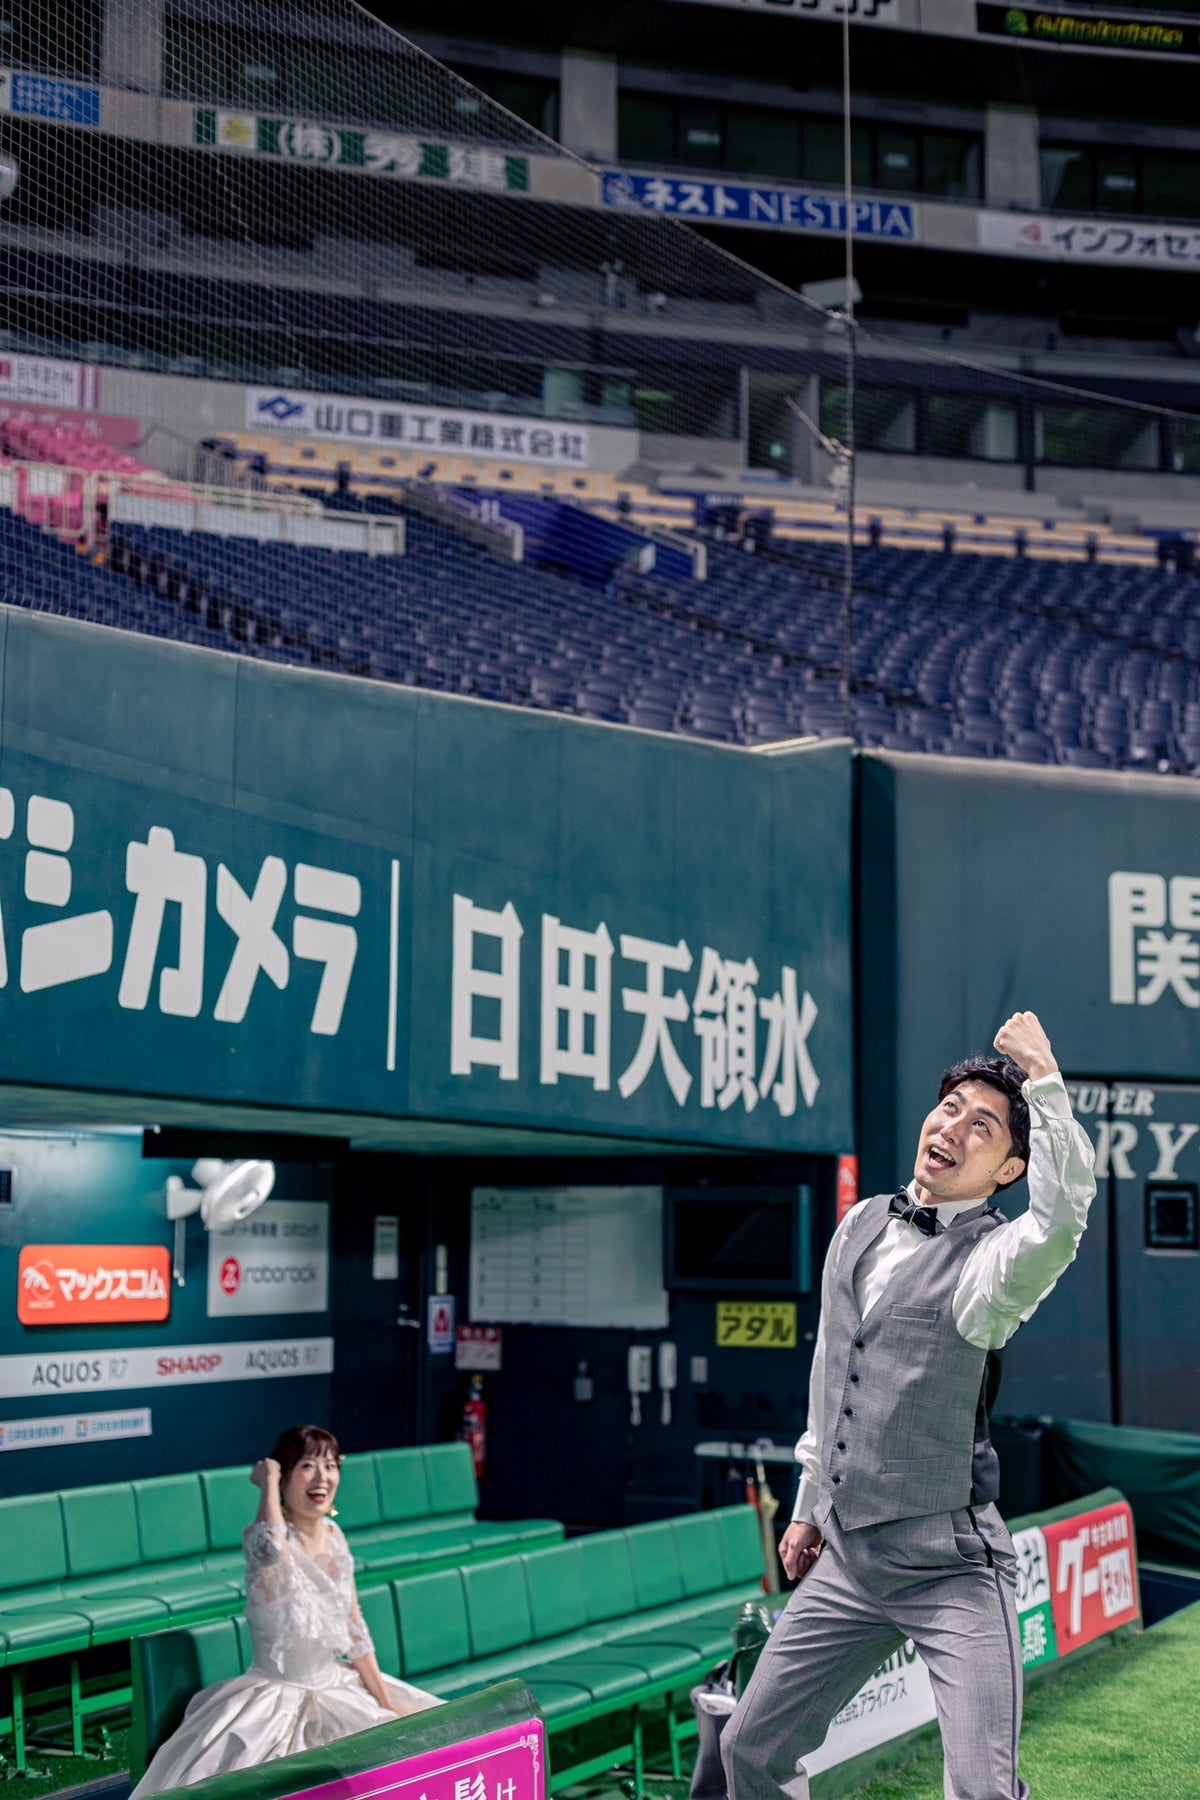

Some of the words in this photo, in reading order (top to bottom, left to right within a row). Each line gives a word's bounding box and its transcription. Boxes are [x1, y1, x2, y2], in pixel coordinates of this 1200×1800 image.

[643, 178, 739, 216] ネスト
[750, 190, 911, 236] NESTPIA
[1053, 226, 1200, 260] インフォセ
[315, 403, 583, 461] 山口重工業株式会社
[1108, 871, 1200, 1008] 関
[451, 893, 820, 1117] 日田天領水
[55, 1266, 167, 1301] マックスコム
[722, 1316, 793, 1342] アタル
[32, 1361, 101, 1388] AQUOS
[156, 1353, 222, 1376] SHARP
[244, 1347, 299, 1371] AQUOS
